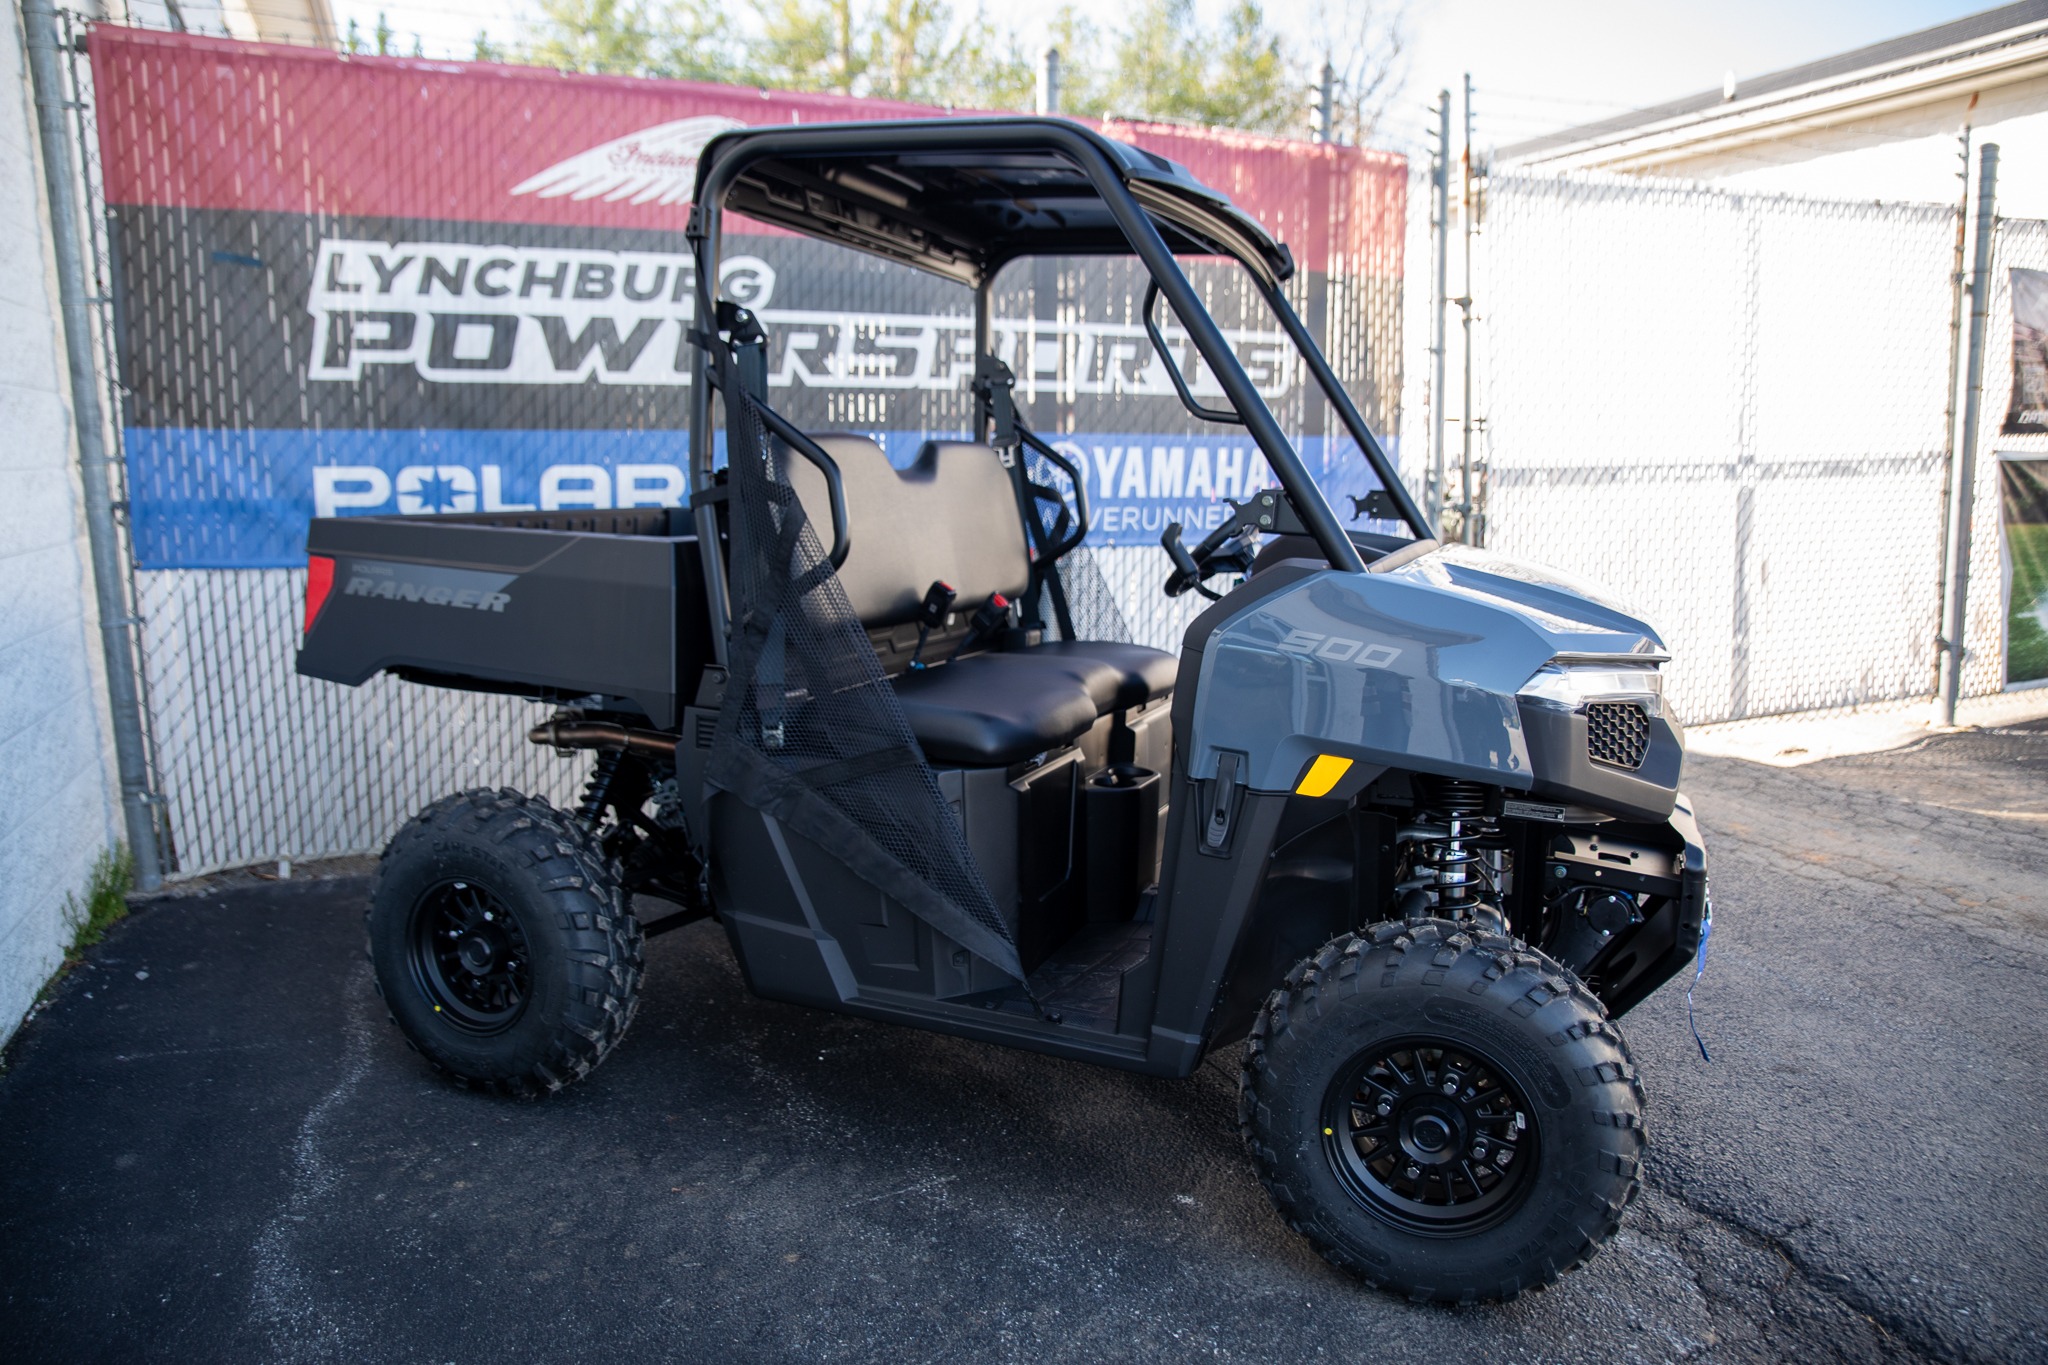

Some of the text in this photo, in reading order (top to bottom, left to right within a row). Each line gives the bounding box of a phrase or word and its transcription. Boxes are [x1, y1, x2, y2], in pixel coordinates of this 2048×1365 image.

[1092, 446, 1282, 499] YAMAHA
[344, 576, 512, 613] RANGER
[1276, 629, 1403, 669] 500
